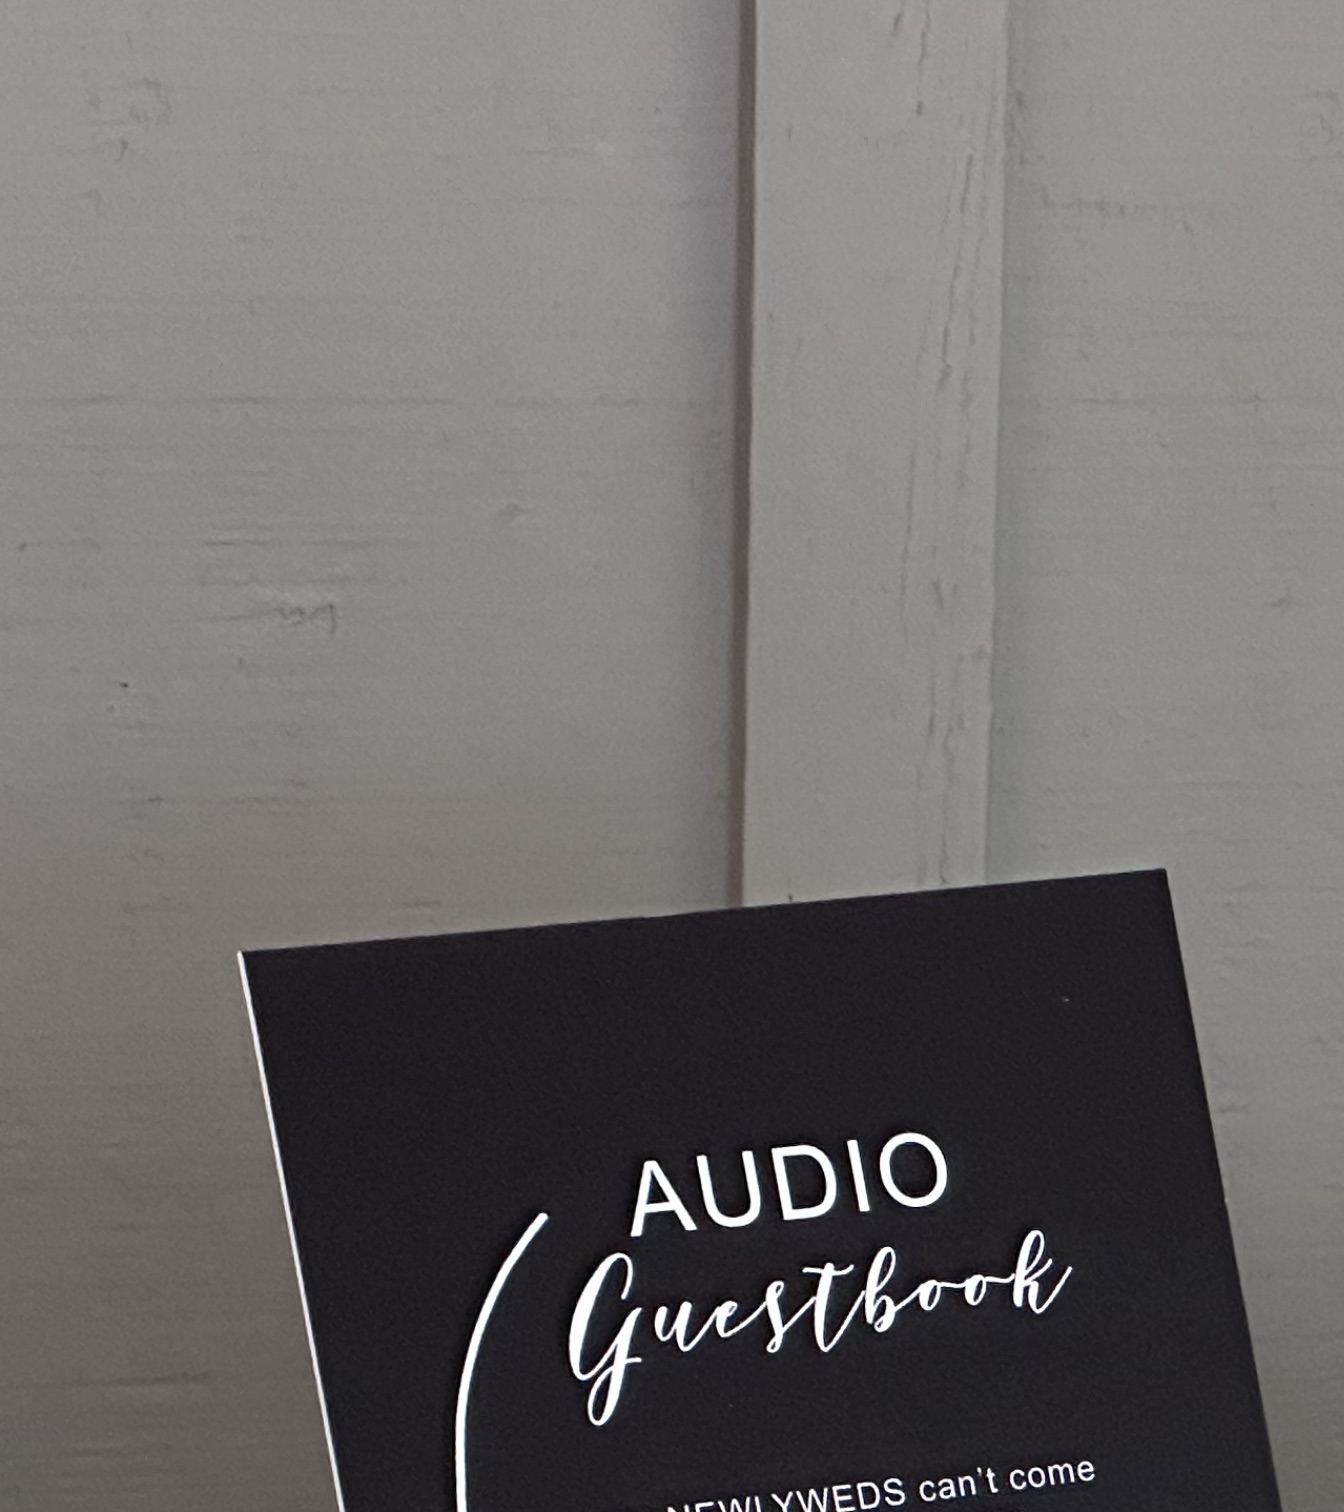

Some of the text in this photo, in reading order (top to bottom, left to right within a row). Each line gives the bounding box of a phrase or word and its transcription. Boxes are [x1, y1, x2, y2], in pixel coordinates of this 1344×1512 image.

[630, 1131, 948, 1238] AUDIO
[568, 1229, 1073, 1427] Guestbook
[918, 1466, 999, 1502] can't
[1009, 1460, 1096, 1491] come
